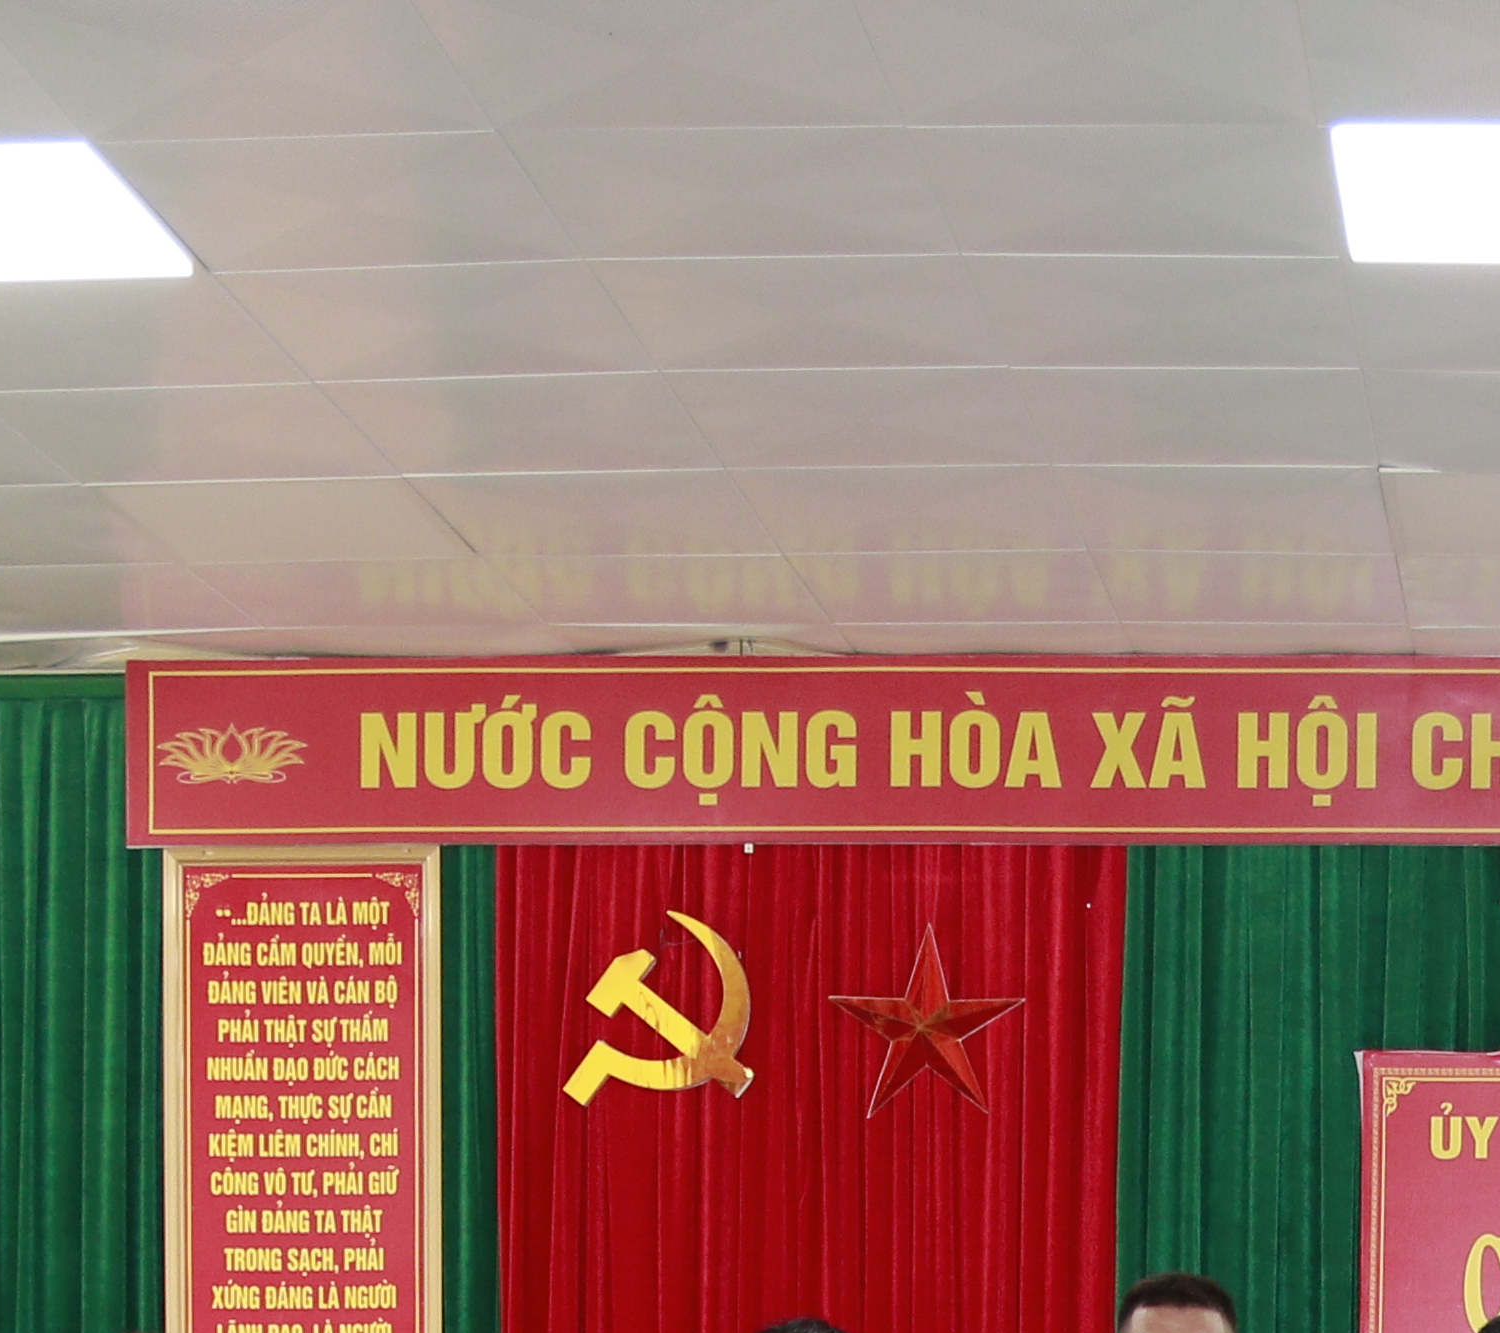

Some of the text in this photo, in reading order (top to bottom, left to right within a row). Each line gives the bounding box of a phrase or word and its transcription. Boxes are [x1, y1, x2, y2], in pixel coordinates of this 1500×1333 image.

[361, 695, 591, 788] NƯỚC
[625, 695, 856, 805] CỘNG
[891, 692, 1061, 788] HÒA
[1091, 696, 1206, 788] XÃ
[1238, 695, 1377, 806] HỘI
[299, 900, 322, 925] TA
[325, 897, 348, 926] LÀ
[352, 896, 390, 929] MỘT
[202, 933, 252, 966] ĐẢNG
[301, 935, 364, 968] QUYỀN,
[368, 933, 403, 966] MỖI
[207, 971, 398, 1008] ĐẢNG VIÊN VÀ CÁN BỘ
[217, 1009, 260, 1043] PHẢI
[263, 1014, 308, 1047] THẬT
[311, 1016, 338, 1047] SỰ
[272, 1056, 309, 1086] ĐẠO
[312, 1050, 349, 1081] ĐỨC
[353, 1053, 400, 1081] CÁCH
[215, 1088, 392, 1124] MẠNG, THỰC SỰ CẦN
[208, 1128, 399, 1162] KIỆM LIÊM CHÍNH, CHÍ
[1431, 1103, 1498, 1159] ỦY
[210, 1161, 400, 1196] CÔNG VÔ TƯ, PHẢI GIỮ
[225, 1200, 384, 1237] GÌN ĐẢNG TA THẬT
[223, 1238, 385, 1276] TRONG SẠCH, PHẢI
[211, 1280, 397, 1310] XỨNG ĐÁNG LÀ NGƯỜI
